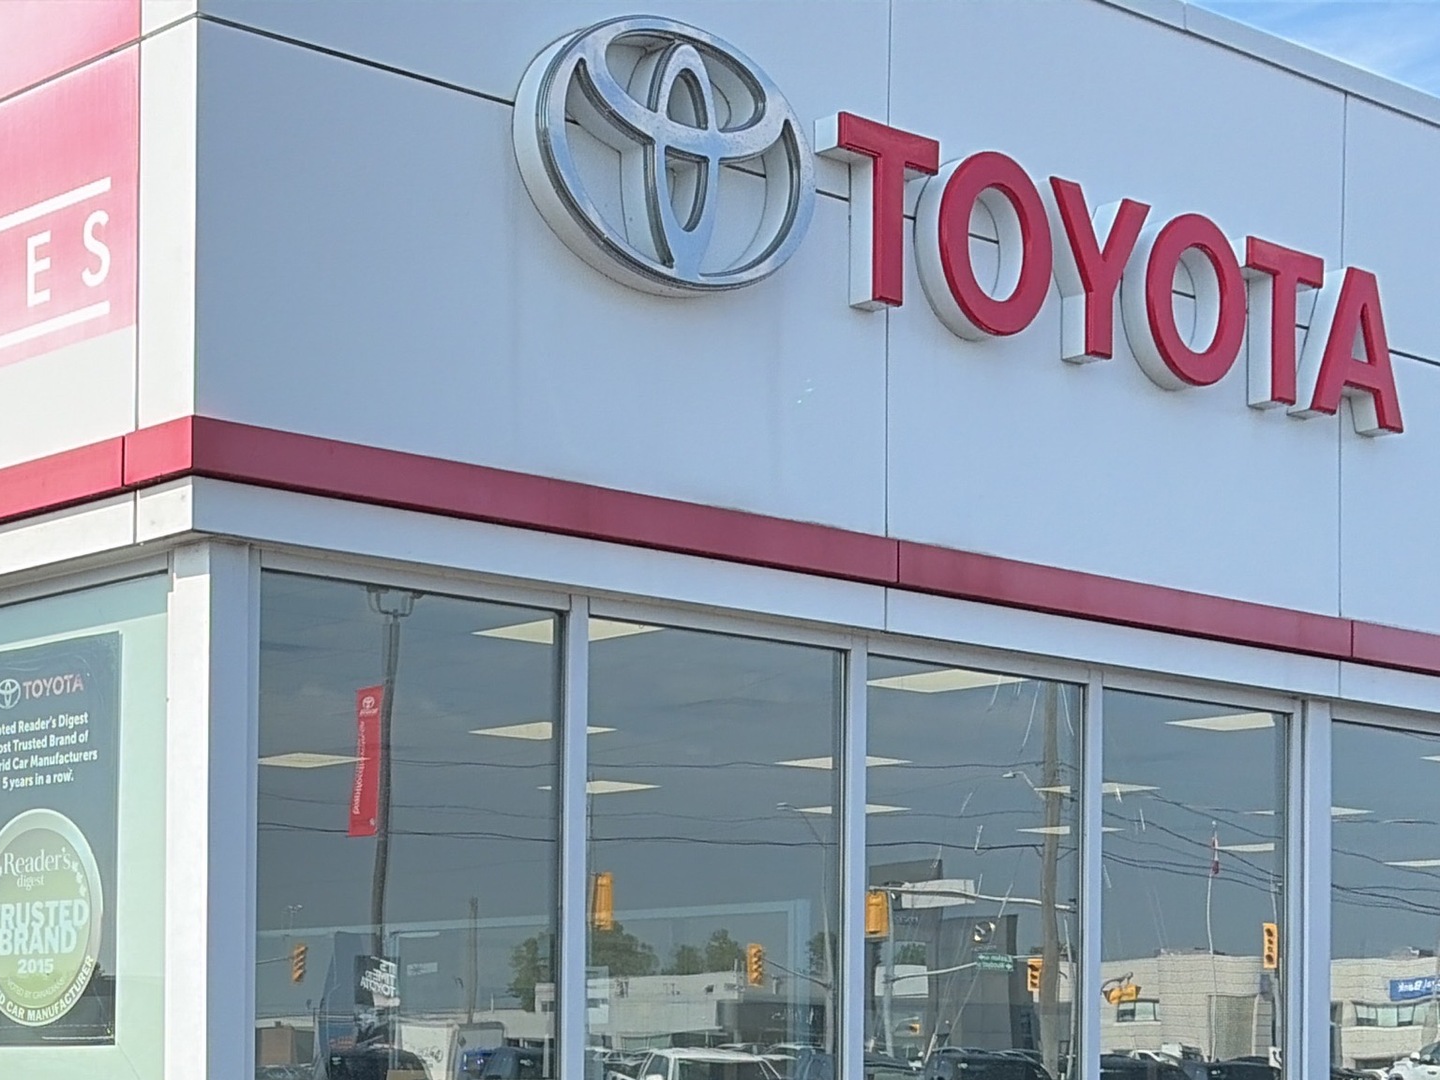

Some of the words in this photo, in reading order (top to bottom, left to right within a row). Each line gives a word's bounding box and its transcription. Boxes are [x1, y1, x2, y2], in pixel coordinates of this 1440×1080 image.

[815, 111, 1404, 437] TOYOTA
[22, 674, 84, 699] TOYOTA
[18, 715, 57, 733] Reader's
[58, 711, 89, 729] Digest
[13, 735, 47, 752] Trusted
[49, 731, 77, 747] Brand
[78, 729, 89, 743] of
[12, 757, 29, 770] Car
[30, 749, 98, 768] Manufacturers
[2, 776, 9, 790] 5
[9, 776, 34, 791] years
[34, 773, 45, 786] in
[46, 773, 52, 784] a
[3, 847, 72, 877] Reader's
[16, 873, 45, 890] digest
[17, 958, 54, 975] 2015
[6, 1001, 26, 1019] CAR
[27, 955, 95, 1021] MANUFACTURER
